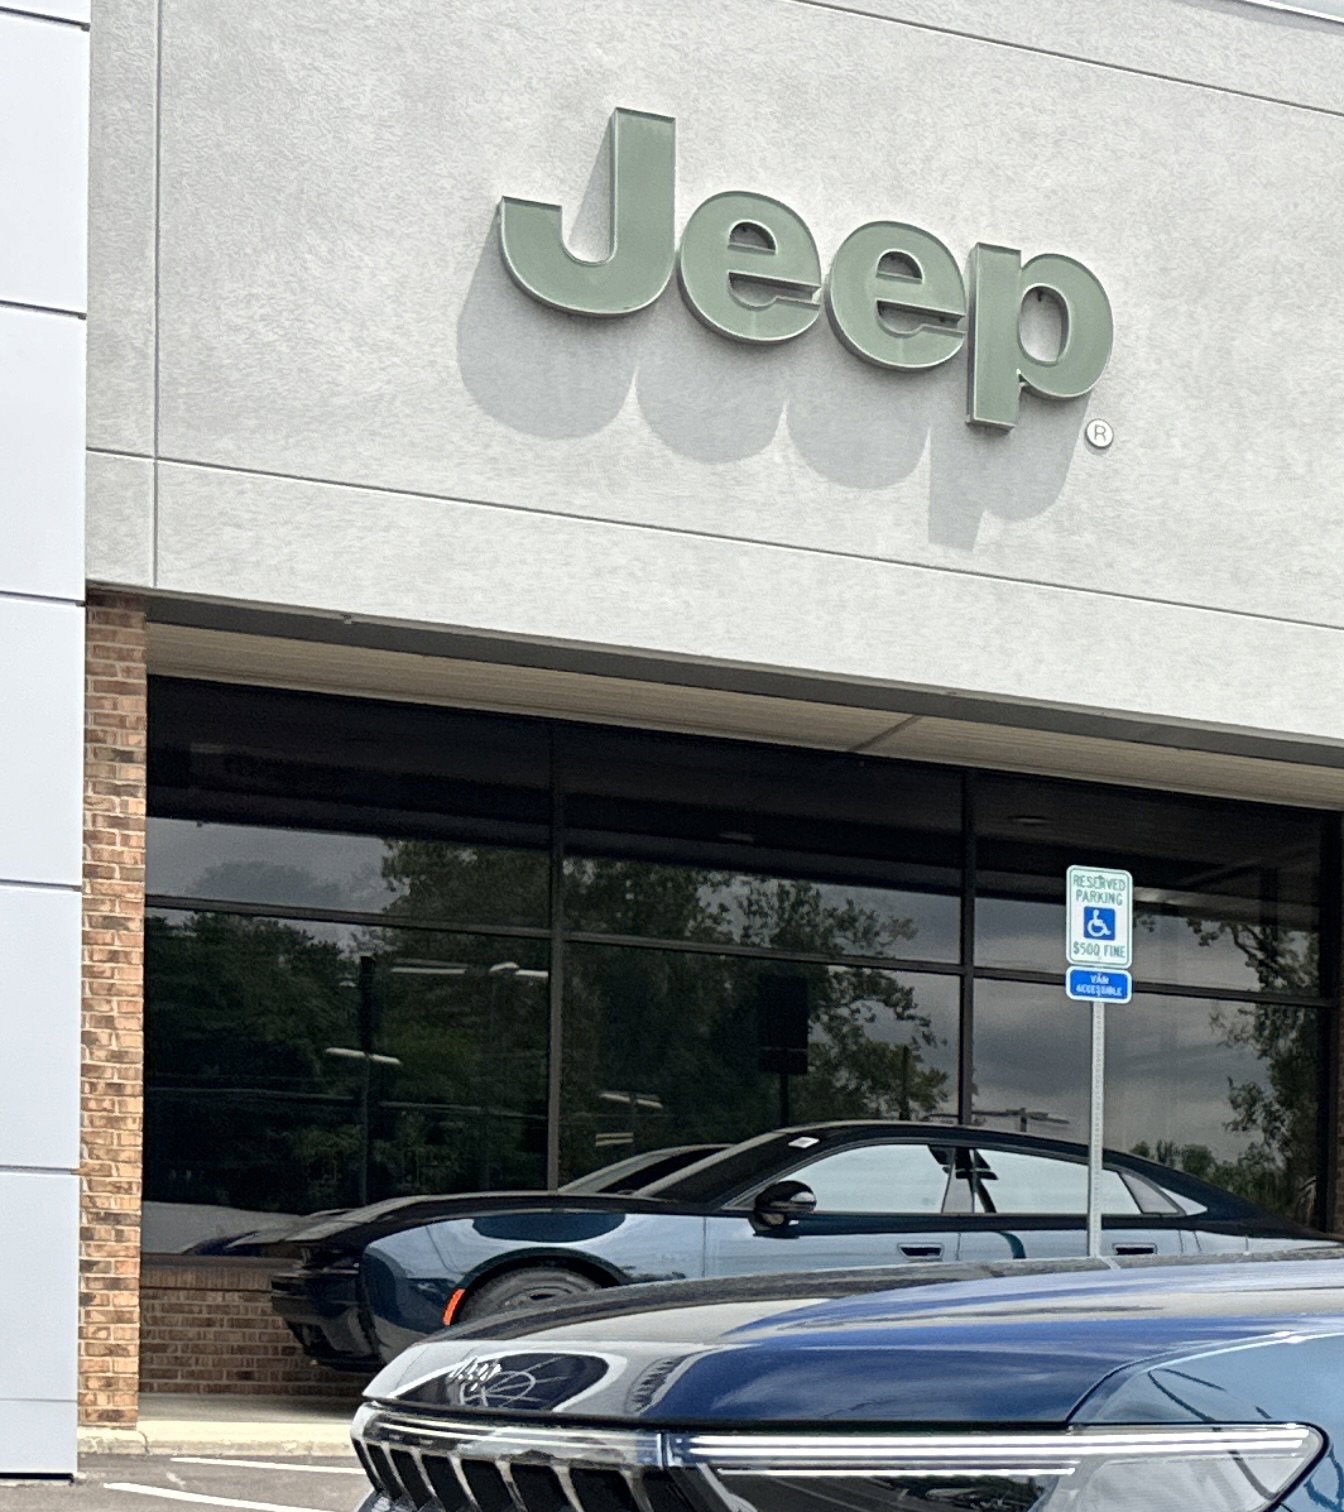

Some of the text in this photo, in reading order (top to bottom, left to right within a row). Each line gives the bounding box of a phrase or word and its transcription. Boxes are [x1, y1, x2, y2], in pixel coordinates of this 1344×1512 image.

[499, 107, 1114, 432] Jeep
[1073, 874, 1126, 891] RESERVED
[1076, 889, 1123, 906] PARKING
[1073, 941, 1126, 958] $500 FINE
